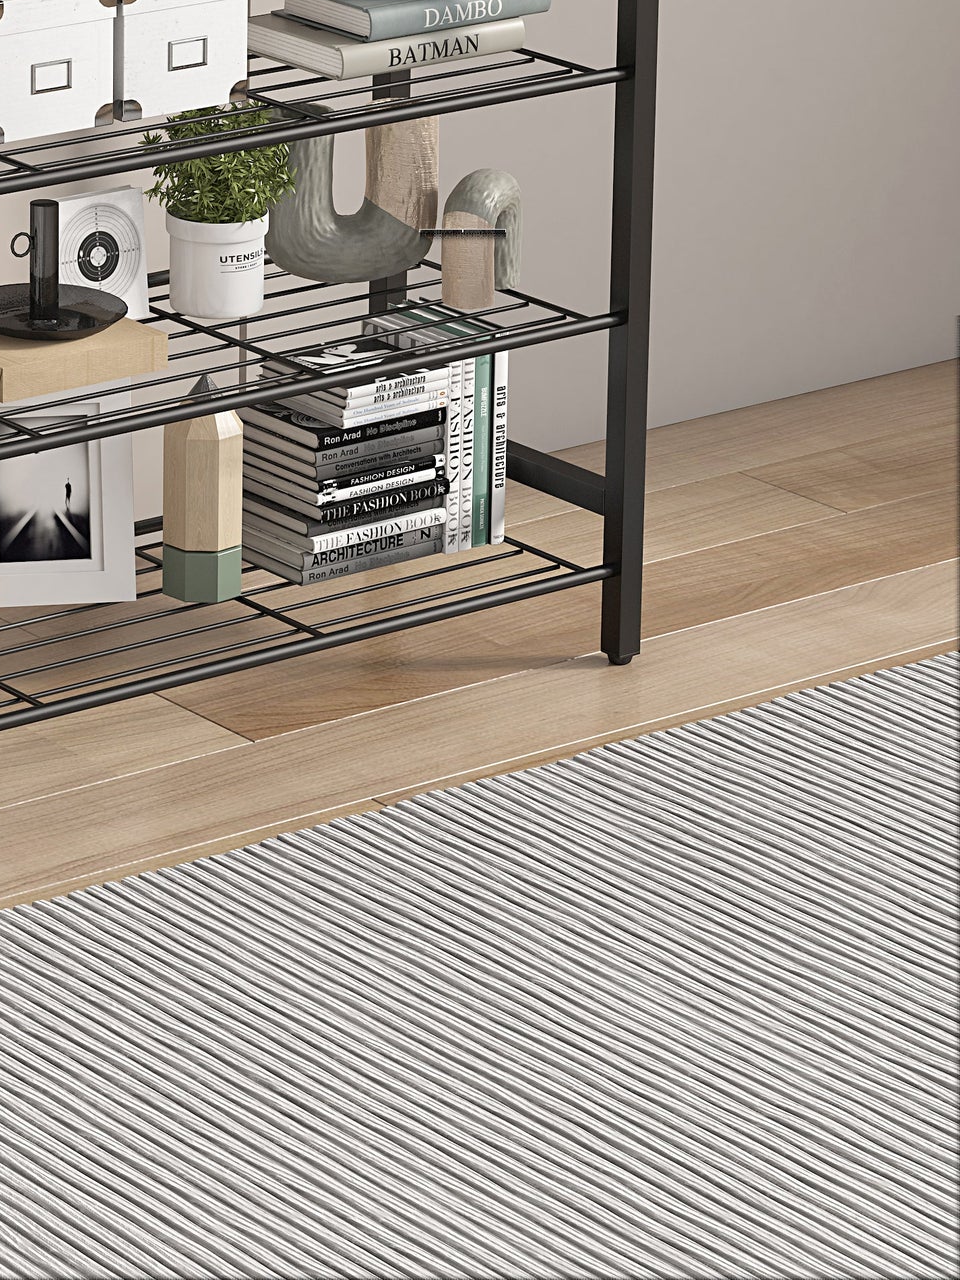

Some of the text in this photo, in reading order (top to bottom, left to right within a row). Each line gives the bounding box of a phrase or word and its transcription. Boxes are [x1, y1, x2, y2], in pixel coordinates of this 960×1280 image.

[388, 33, 480, 67] BATMAN
[219, 247, 264, 264] UTENSILS
[496, 385, 507, 407] arts
[324, 418, 417, 446] Ron Arad No Discipline
[449, 396, 461, 484] FASHION
[462, 394, 474, 481] FASHION
[321, 451, 338, 461] Ron
[340, 446, 359, 458] Arad
[335, 456, 378, 471] Conversations
[392, 446, 421, 459] Architects
[494, 423, 506, 489] architecture
[349, 477, 415, 498] FASHION DESIGN
[350, 471, 385, 486] FASHION
[386, 464, 415, 477] DESIGN
[322, 505, 351, 522] THE
[353, 492, 408, 516] FASHION
[410, 482, 446, 502] BOOK
[447, 490, 459, 546] BOOK
[460, 486, 472, 543] BOOK
[315, 534, 344, 551] THE
[346, 522, 402, 544] FASHION
[405, 512, 442, 530] BOOK
[311, 534, 404, 567] ARCHITECTURE
[308, 570, 327, 581] Ron
[328, 564, 349, 577] Arad
